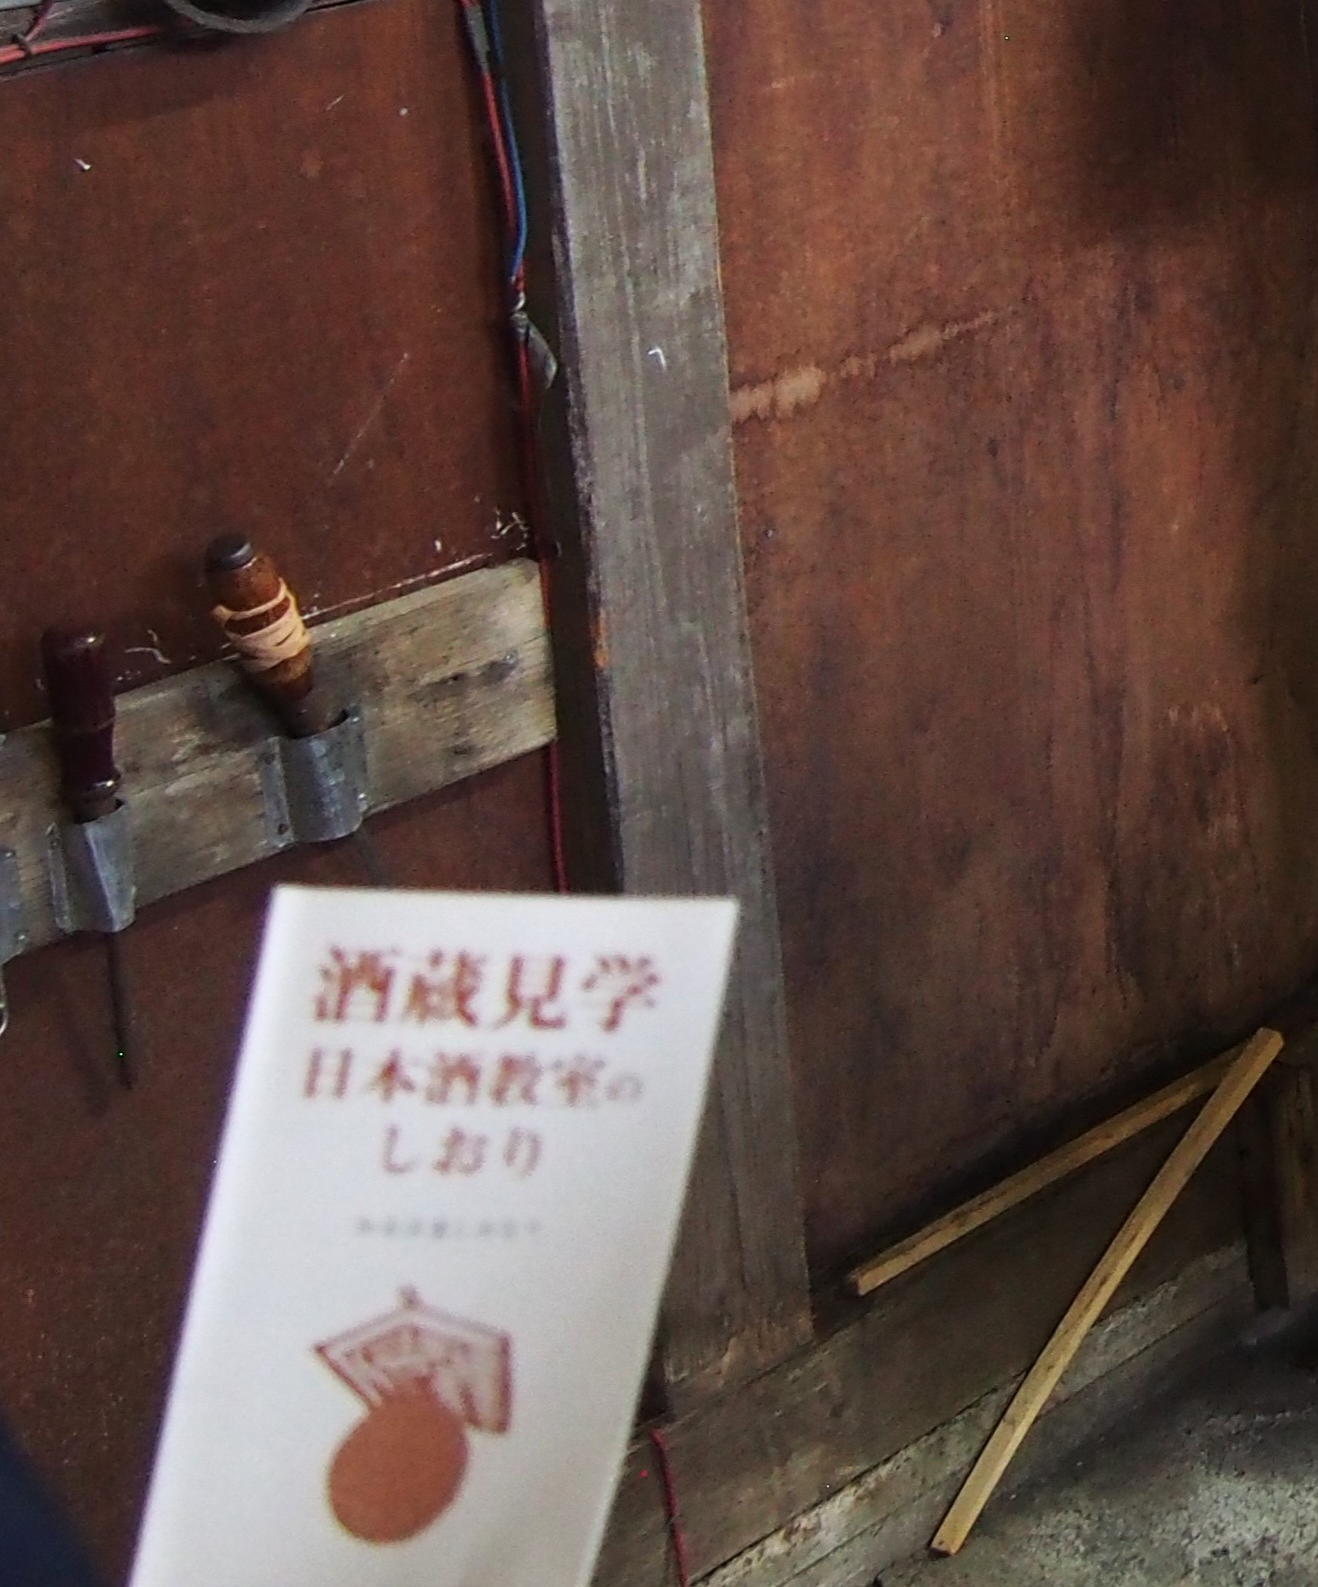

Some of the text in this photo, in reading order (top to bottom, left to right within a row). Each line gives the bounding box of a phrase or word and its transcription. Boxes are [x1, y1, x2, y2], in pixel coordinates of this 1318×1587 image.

[312, 945, 662, 1034] 酒蔵見学
[302, 1047, 645, 1110] 日本酒教室の
[382, 1123, 545, 1178] しおり
